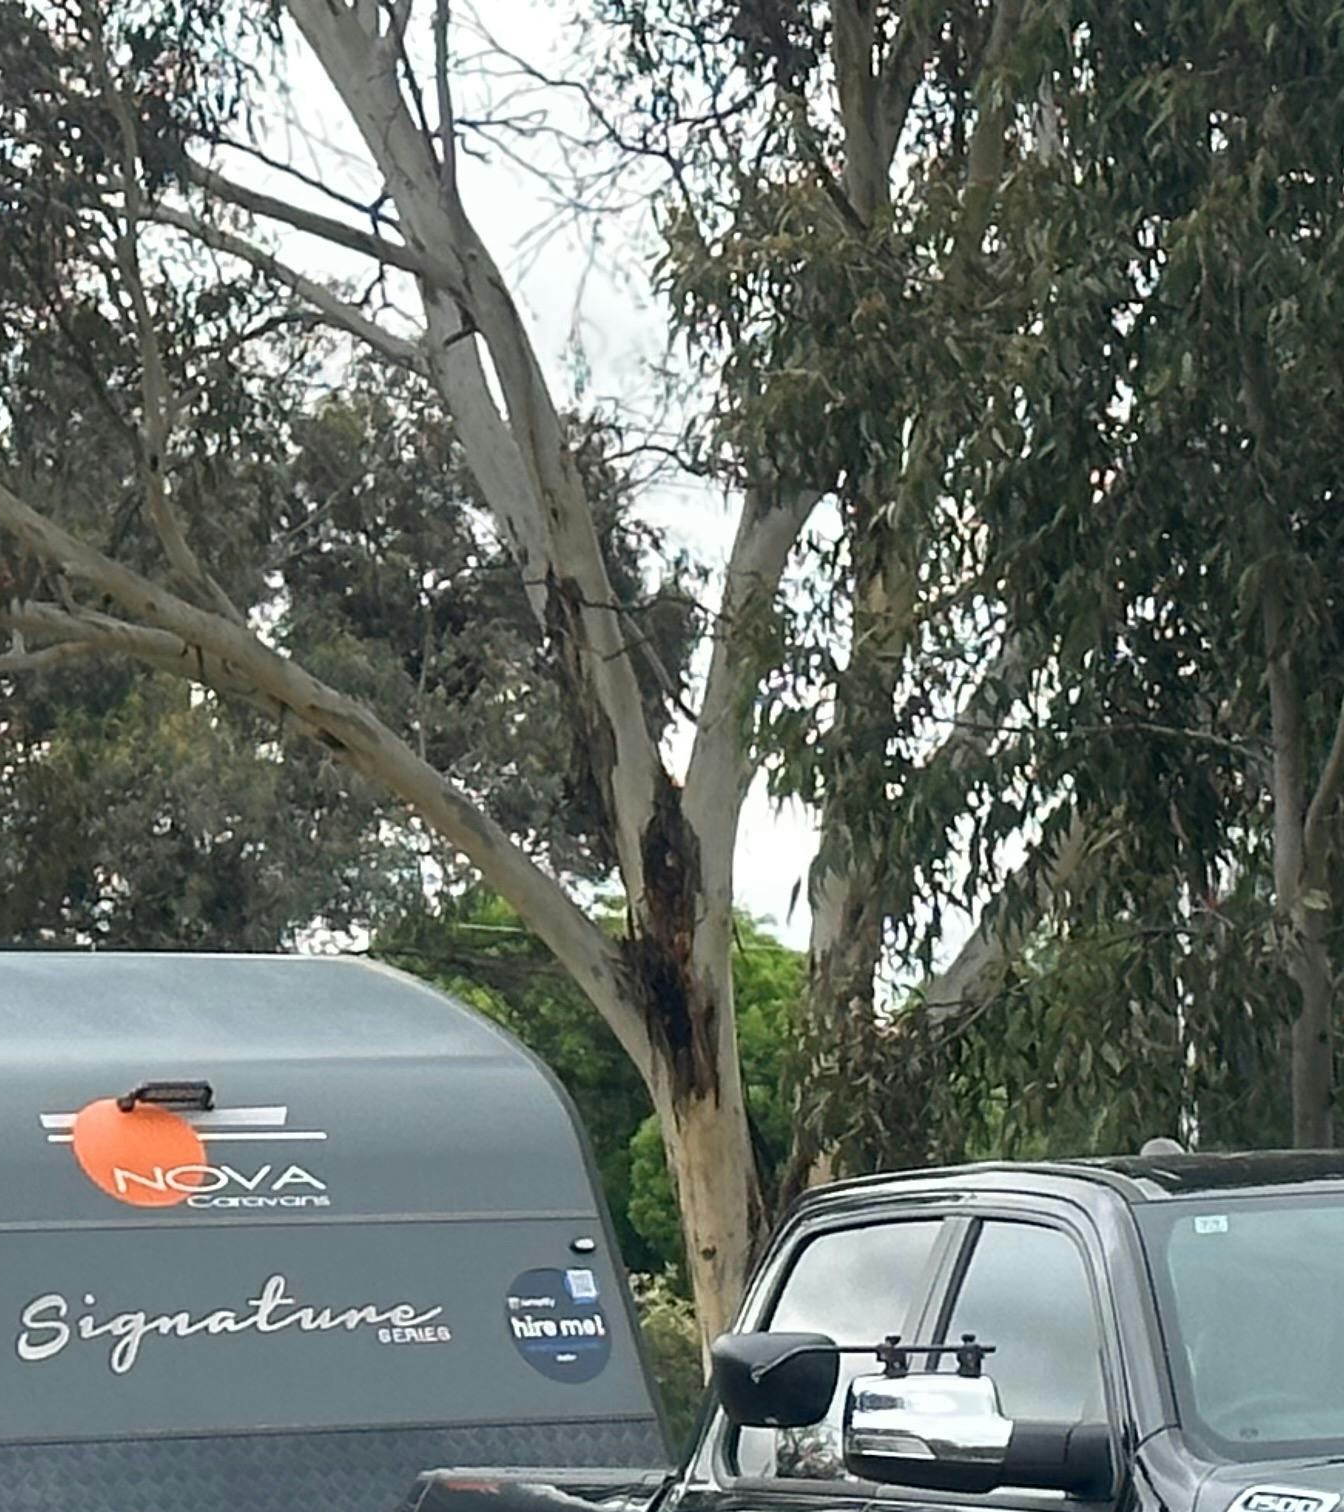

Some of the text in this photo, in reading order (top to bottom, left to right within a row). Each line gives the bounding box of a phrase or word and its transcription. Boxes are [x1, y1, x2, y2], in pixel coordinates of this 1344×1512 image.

[113, 1164, 327, 1193] NOVA
[187, 1194, 331, 1209] Caravans
[17, 1274, 443, 1374] Signature
[378, 1326, 452, 1344] SERIES
